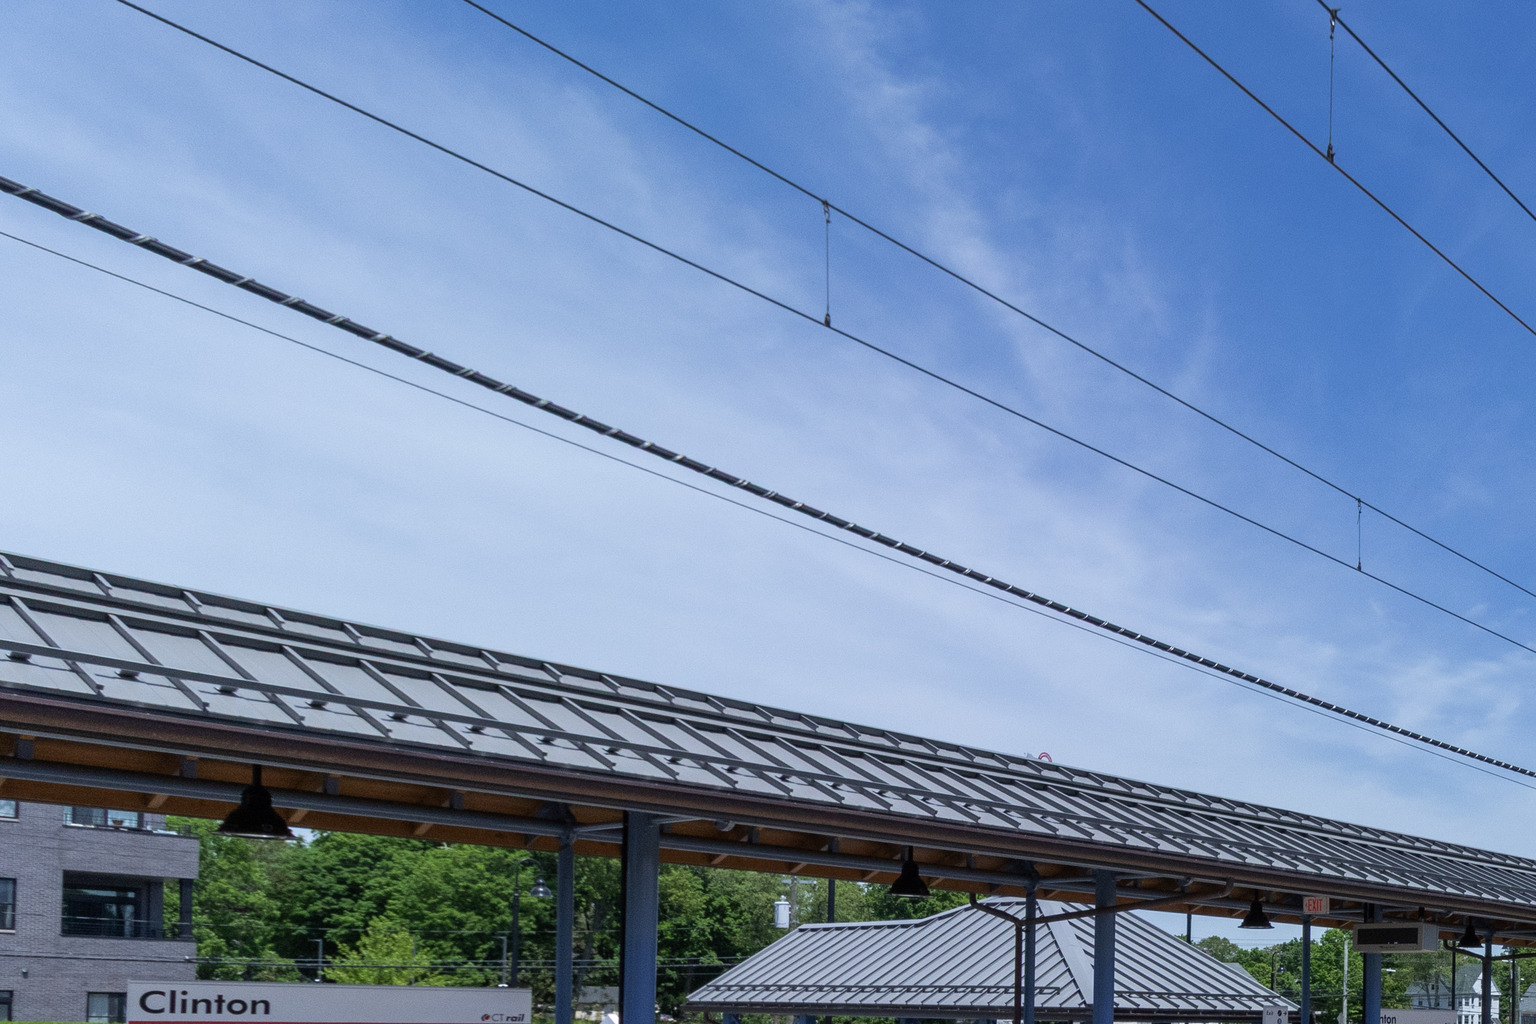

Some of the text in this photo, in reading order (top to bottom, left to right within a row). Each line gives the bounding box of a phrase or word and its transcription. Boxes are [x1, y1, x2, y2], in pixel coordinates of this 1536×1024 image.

[1307, 898, 1323, 912] EXIT
[139, 990, 270, 1015] Clinton
[506, 1014, 525, 1022] rail
[1380, 1014, 1396, 1024] nton
